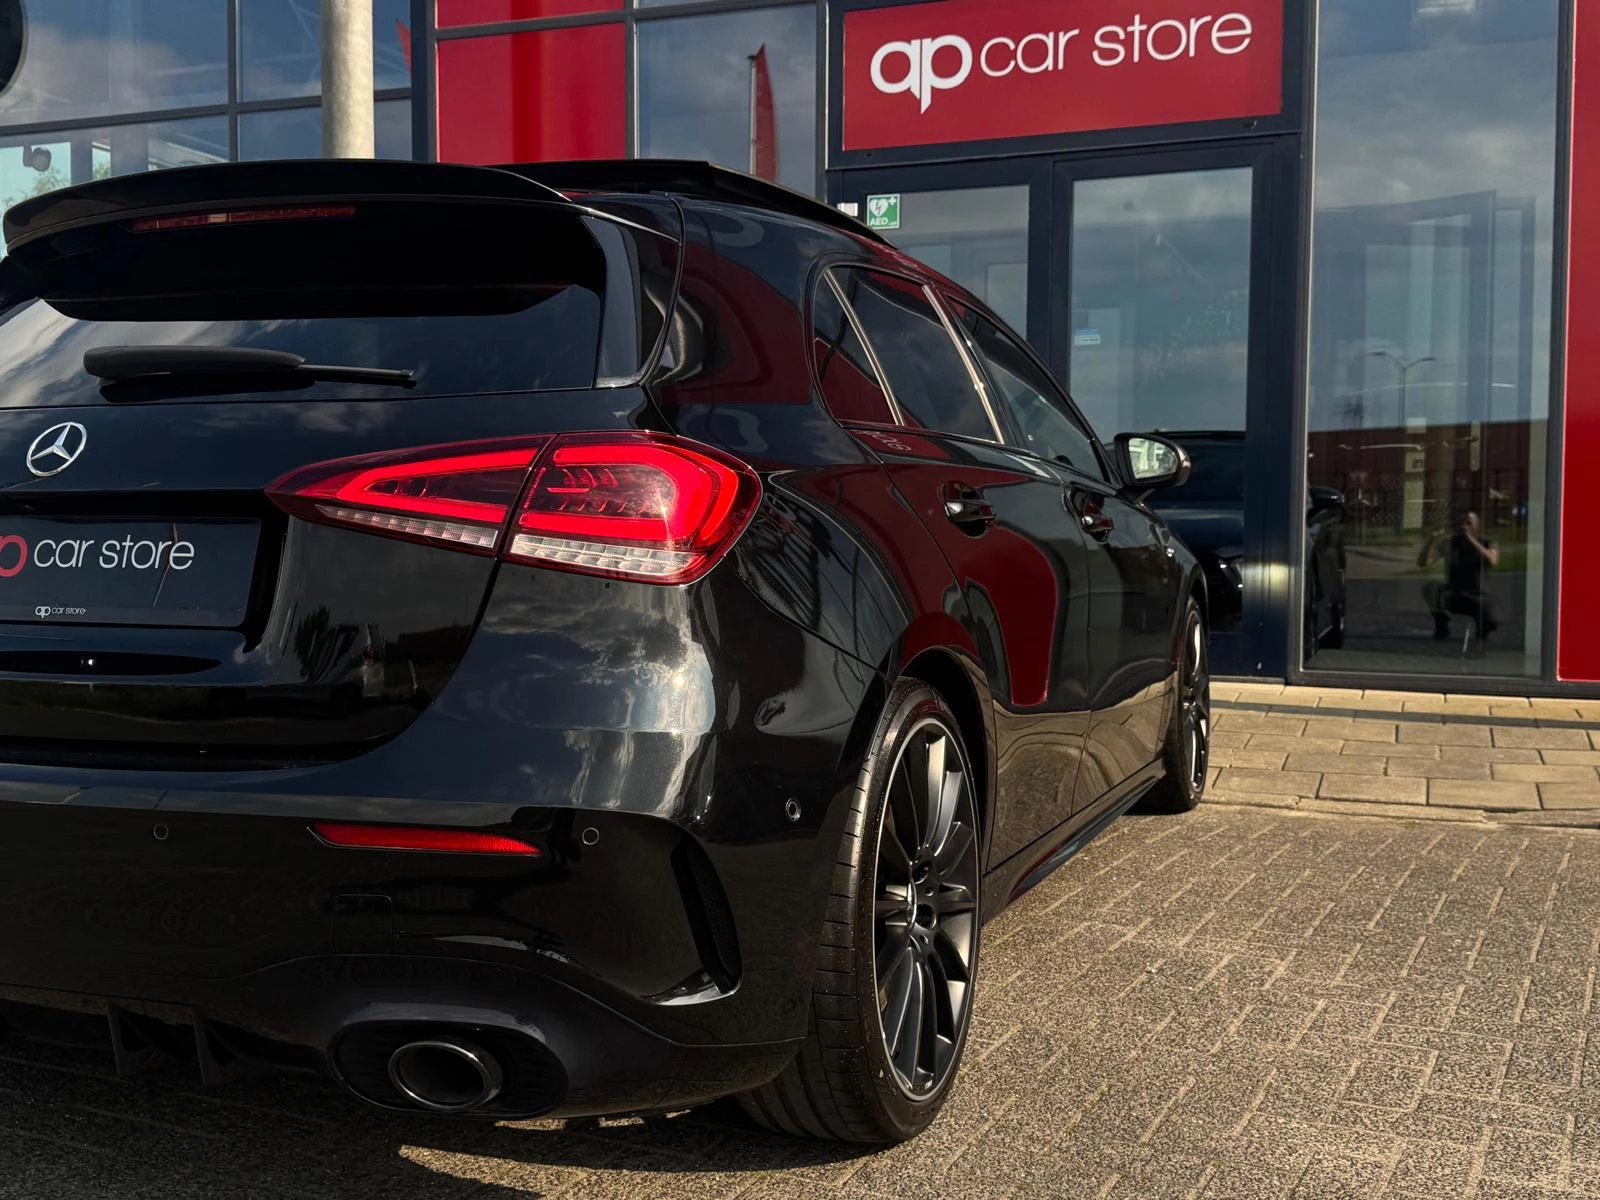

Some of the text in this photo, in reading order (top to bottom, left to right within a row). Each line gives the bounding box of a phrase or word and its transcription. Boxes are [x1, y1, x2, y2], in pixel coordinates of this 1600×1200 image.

[870, 12, 1252, 115] ap car store
[870, 216, 889, 226] AED
[34, 539, 95, 568] car
[99, 534, 195, 570] store
[52, 607, 65, 615] car
[65, 607, 86, 615] store
